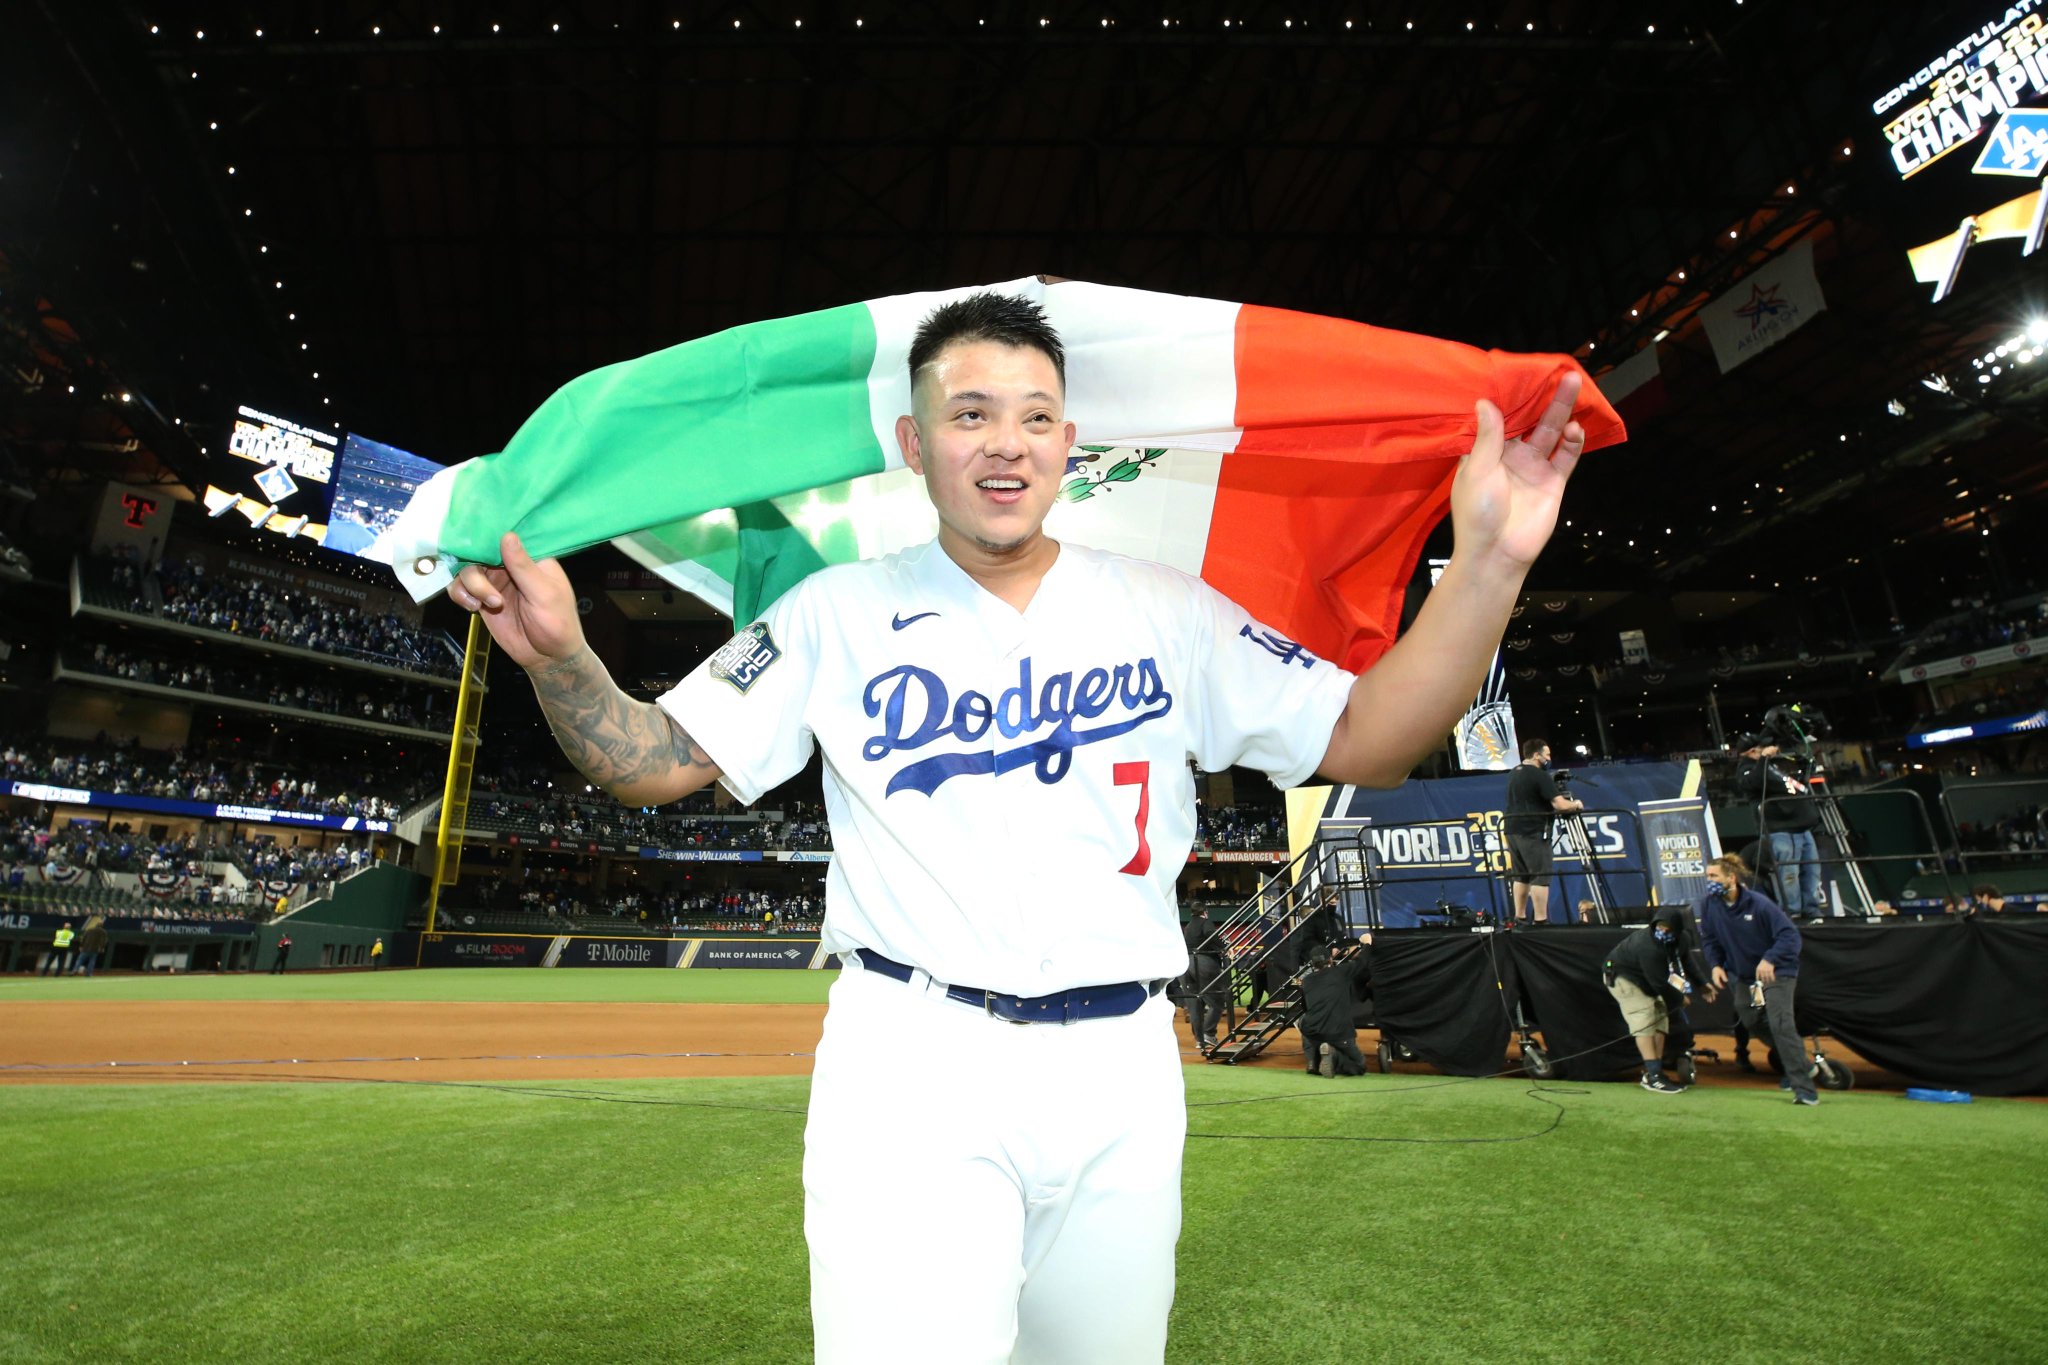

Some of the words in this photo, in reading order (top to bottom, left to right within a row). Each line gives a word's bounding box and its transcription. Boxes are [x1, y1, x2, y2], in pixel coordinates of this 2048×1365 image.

[2001, 13, 2043, 50] 20
[1873, 0, 2047, 115] CONGRATULAT
[1884, 67, 1991, 145] WORLD
[306, 580, 368, 601] BREWING
[862, 656, 1172, 786] Dodgers
[1113, 761, 1151, 876] 7
[1656, 835, 1700, 851] WORLD
[1215, 852, 1274, 862] WHATABURGER
[1687, 850, 1702, 860] 20
[1661, 860, 1705, 876] SERIES
[171, 925, 211, 934] NETWORK
[603, 944, 651, 962] Mobile
[709, 951, 731, 959] BANK
[733, 951, 745, 959] OF
[746, 951, 783, 959] AMERICA
